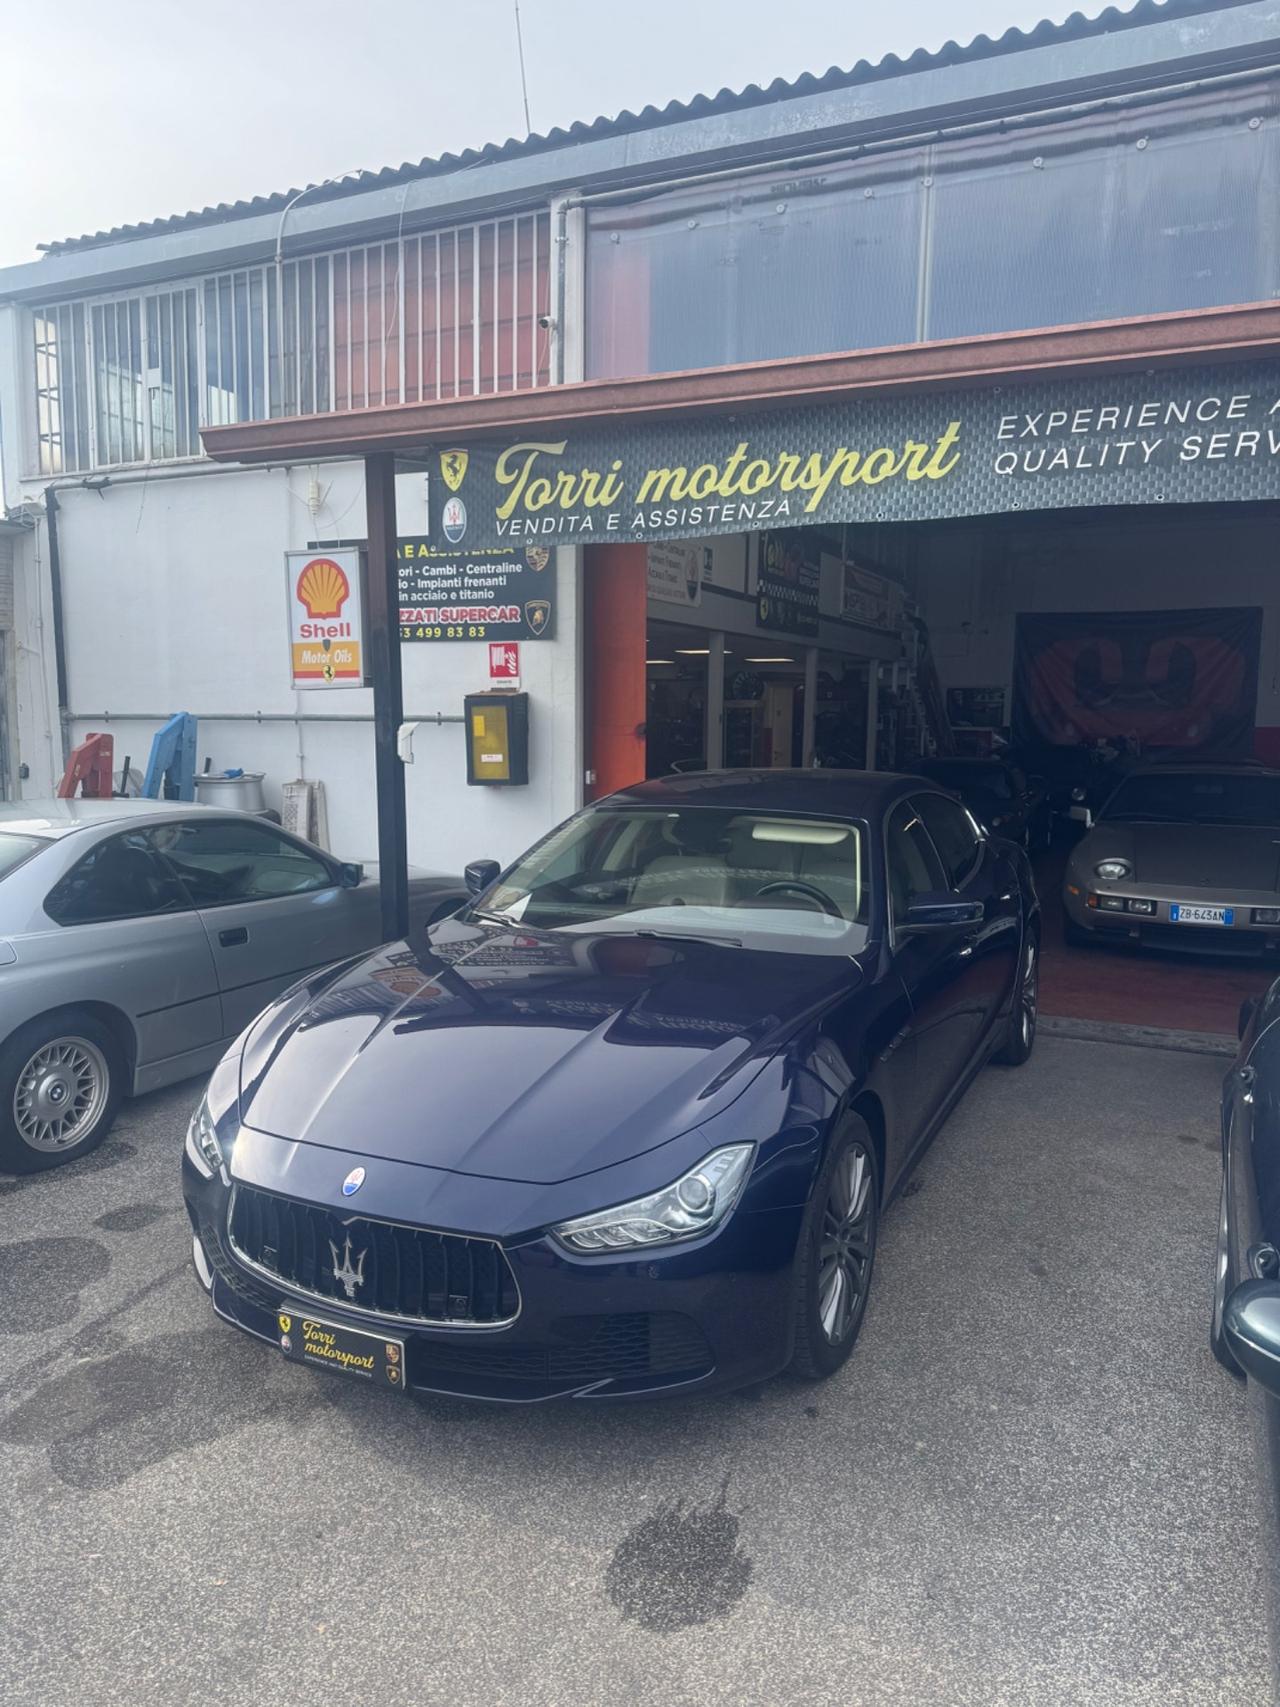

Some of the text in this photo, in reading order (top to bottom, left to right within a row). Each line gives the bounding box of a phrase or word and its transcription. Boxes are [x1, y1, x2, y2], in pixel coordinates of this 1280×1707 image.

[997, 395, 1251, 440] EXPERIENCE
[994, 439, 1162, 475] QUALITY
[495, 421, 960, 520] Torri motorsport
[496, 500, 791, 536] VENDITA E ASSISTENZA
[422, 564, 457, 576] Cambi
[466, 562, 523, 574] Centraline
[417, 577, 462, 590] Impianti
[464, 575, 507, 587] frenanti
[411, 590, 448, 601] acciaio
[450, 592, 458, 600] e
[459, 588, 495, 600] titanio
[439, 606, 521, 623] SUPERCAR
[300, 622, 351, 638] Shell
[416, 627, 441, 638] 499
[447, 627, 463, 638] 83
[468, 626, 485, 638] 83
[302, 648, 353, 664] Motor Oils
[302, 1321, 336, 1345] Torri
[304, 1343, 375, 1369] motorsport
